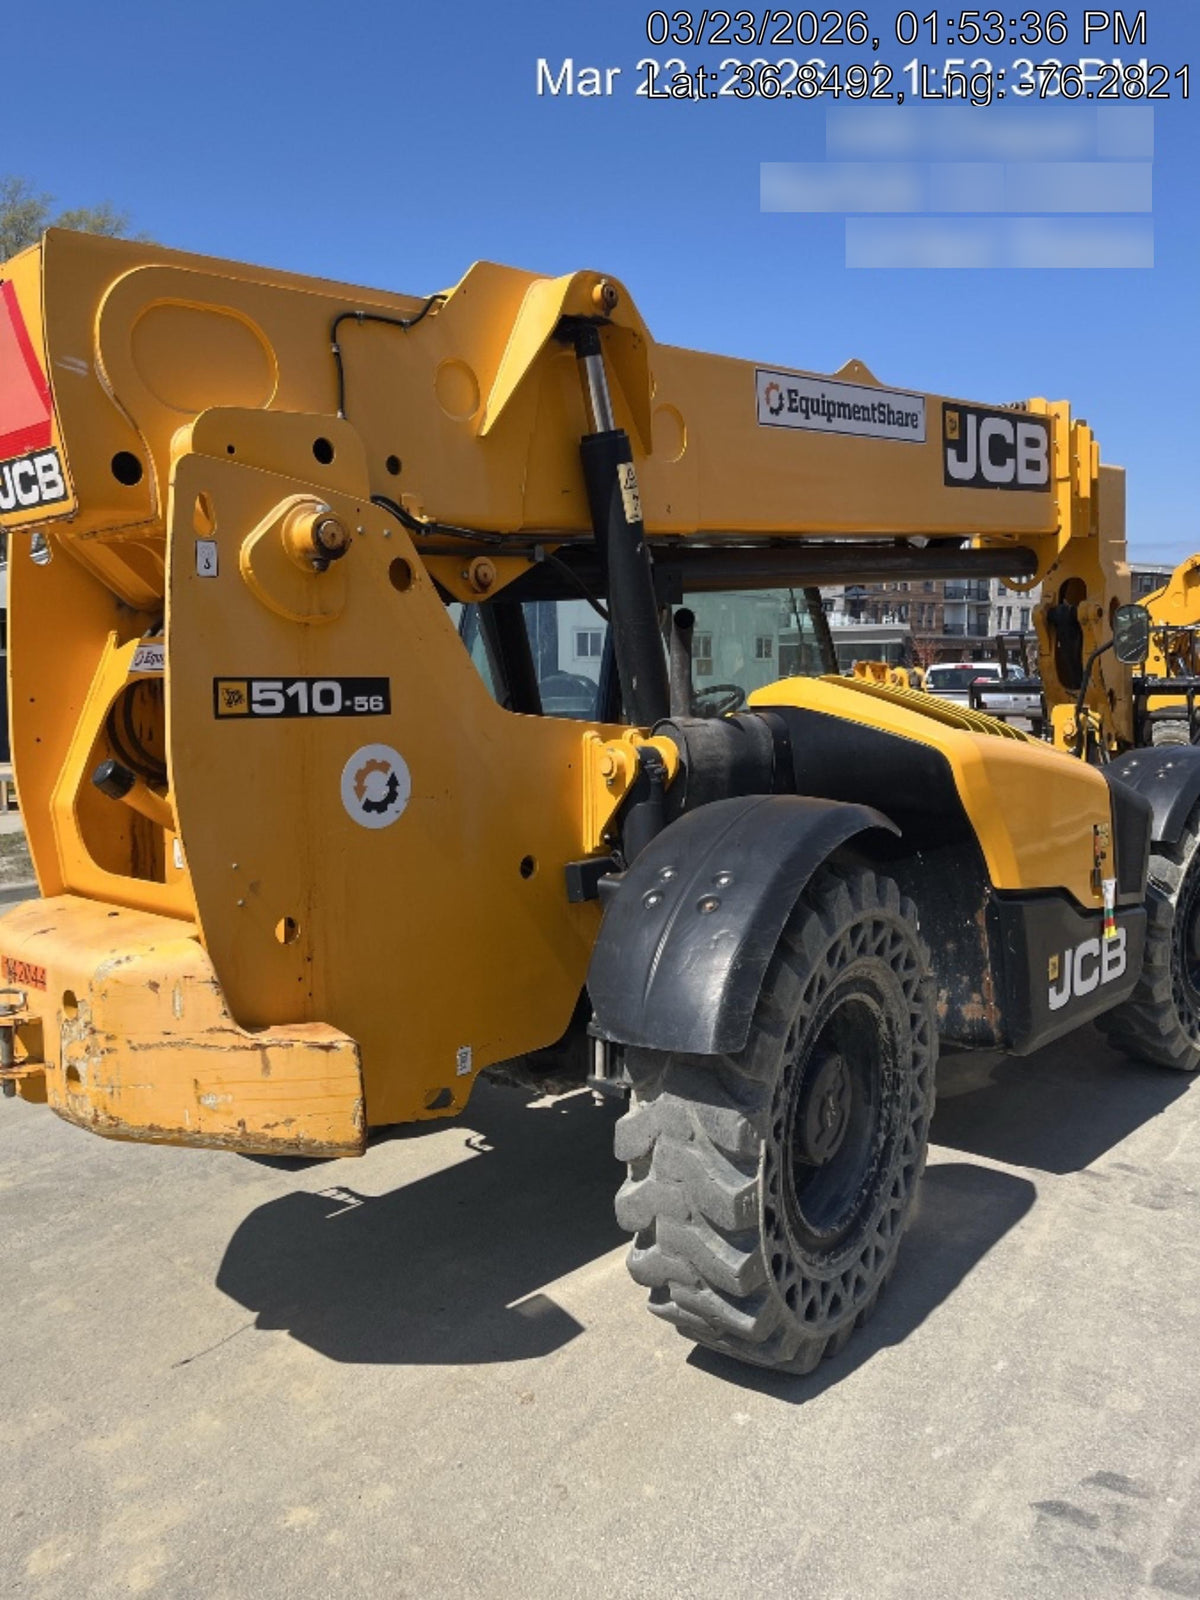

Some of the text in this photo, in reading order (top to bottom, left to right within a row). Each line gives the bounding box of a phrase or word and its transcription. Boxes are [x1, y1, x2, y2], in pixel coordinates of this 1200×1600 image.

[786, 388, 918, 429] EquipmentShare
[0, 453, 65, 509] JCB
[946, 413, 1050, 485] JCB
[1049, 928, 1126, 1010] JCB
